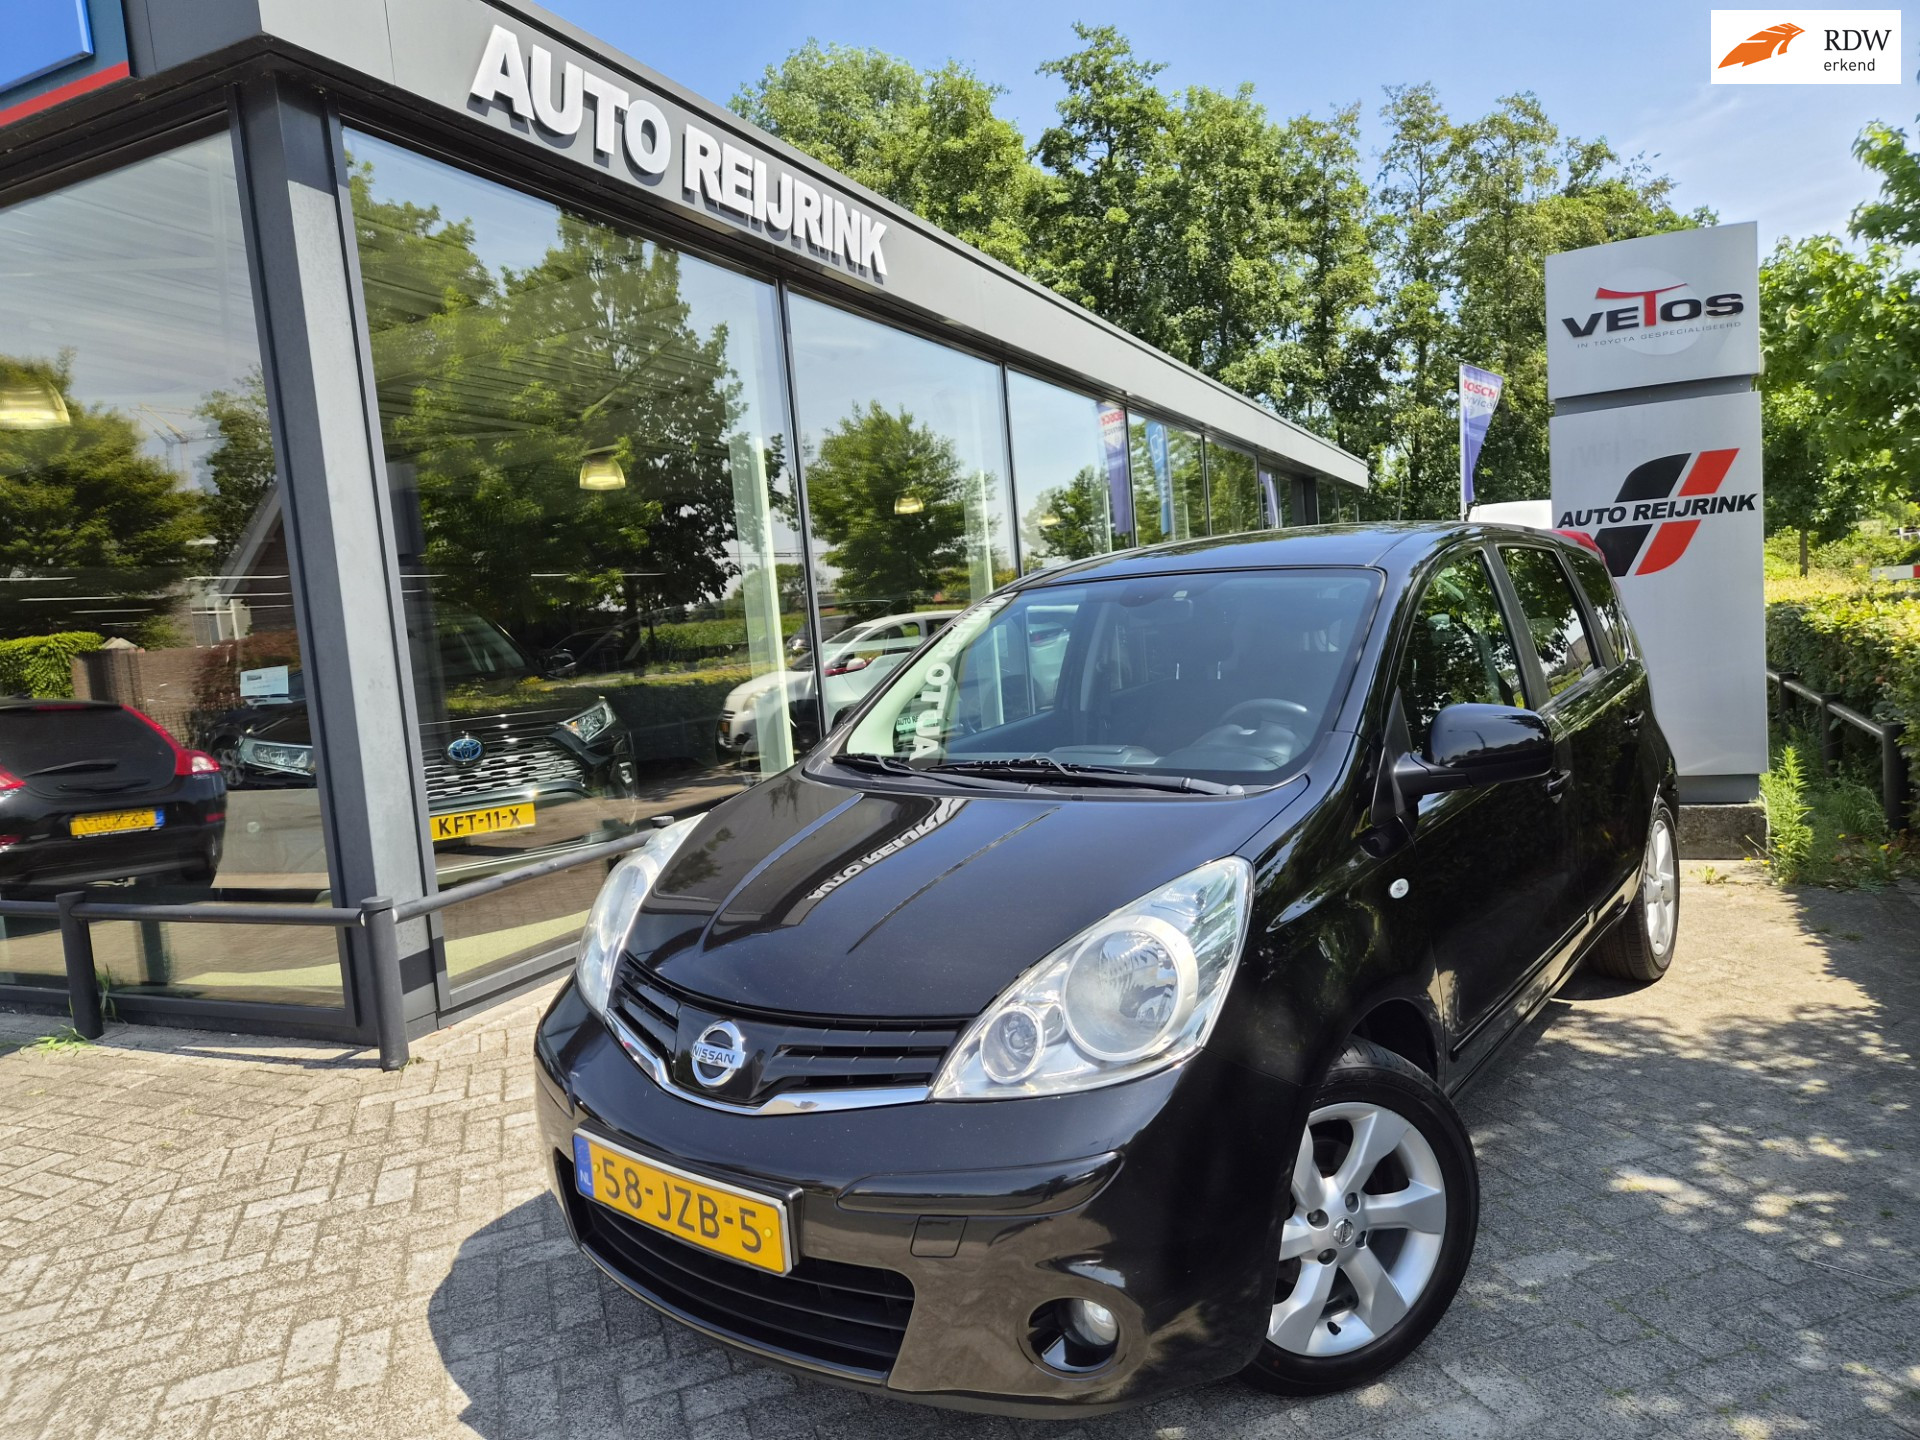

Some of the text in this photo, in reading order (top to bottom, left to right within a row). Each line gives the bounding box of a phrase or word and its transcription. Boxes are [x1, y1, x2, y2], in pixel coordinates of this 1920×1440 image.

[468, 24, 889, 277] AUTO REIJRINK
[1561, 283, 1744, 339] VETOS
[1594, 336, 1635, 346] TOYOTA
[1640, 321, 1742, 340] GESPECIALISEERD
[1556, 493, 1758, 529] AUTO REIJRINK
[438, 807, 520, 836] KFT-11-X
[692, 1044, 736, 1064] NISSAN
[579, 1156, 762, 1254] NL 58-JZB-5
